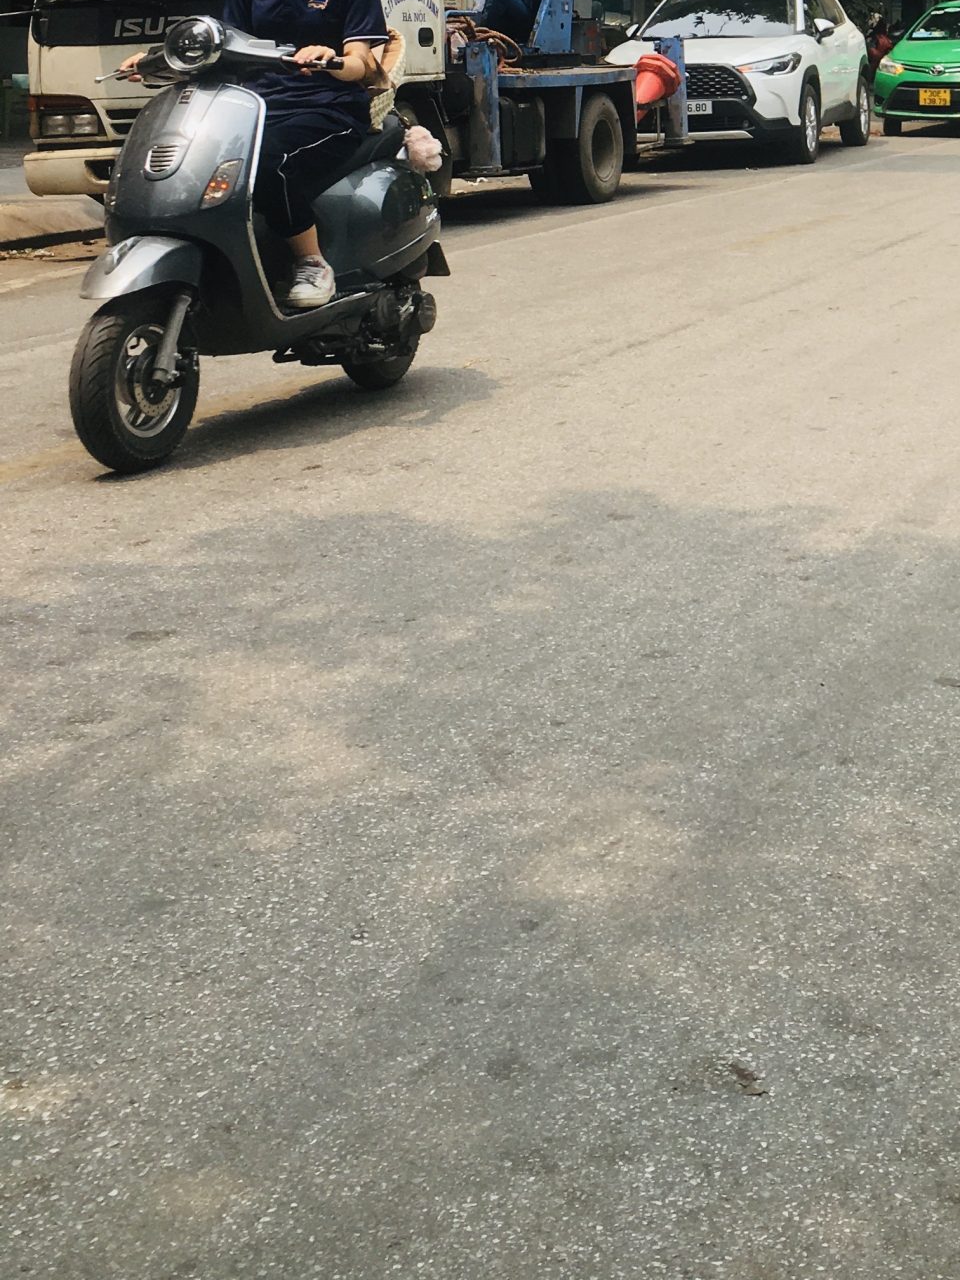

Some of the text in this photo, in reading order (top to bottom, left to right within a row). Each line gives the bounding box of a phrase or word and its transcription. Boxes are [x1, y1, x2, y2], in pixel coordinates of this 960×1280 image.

[402, 9, 426, 24] HÀ NỘI
[114, 16, 187, 37] ISUZ
